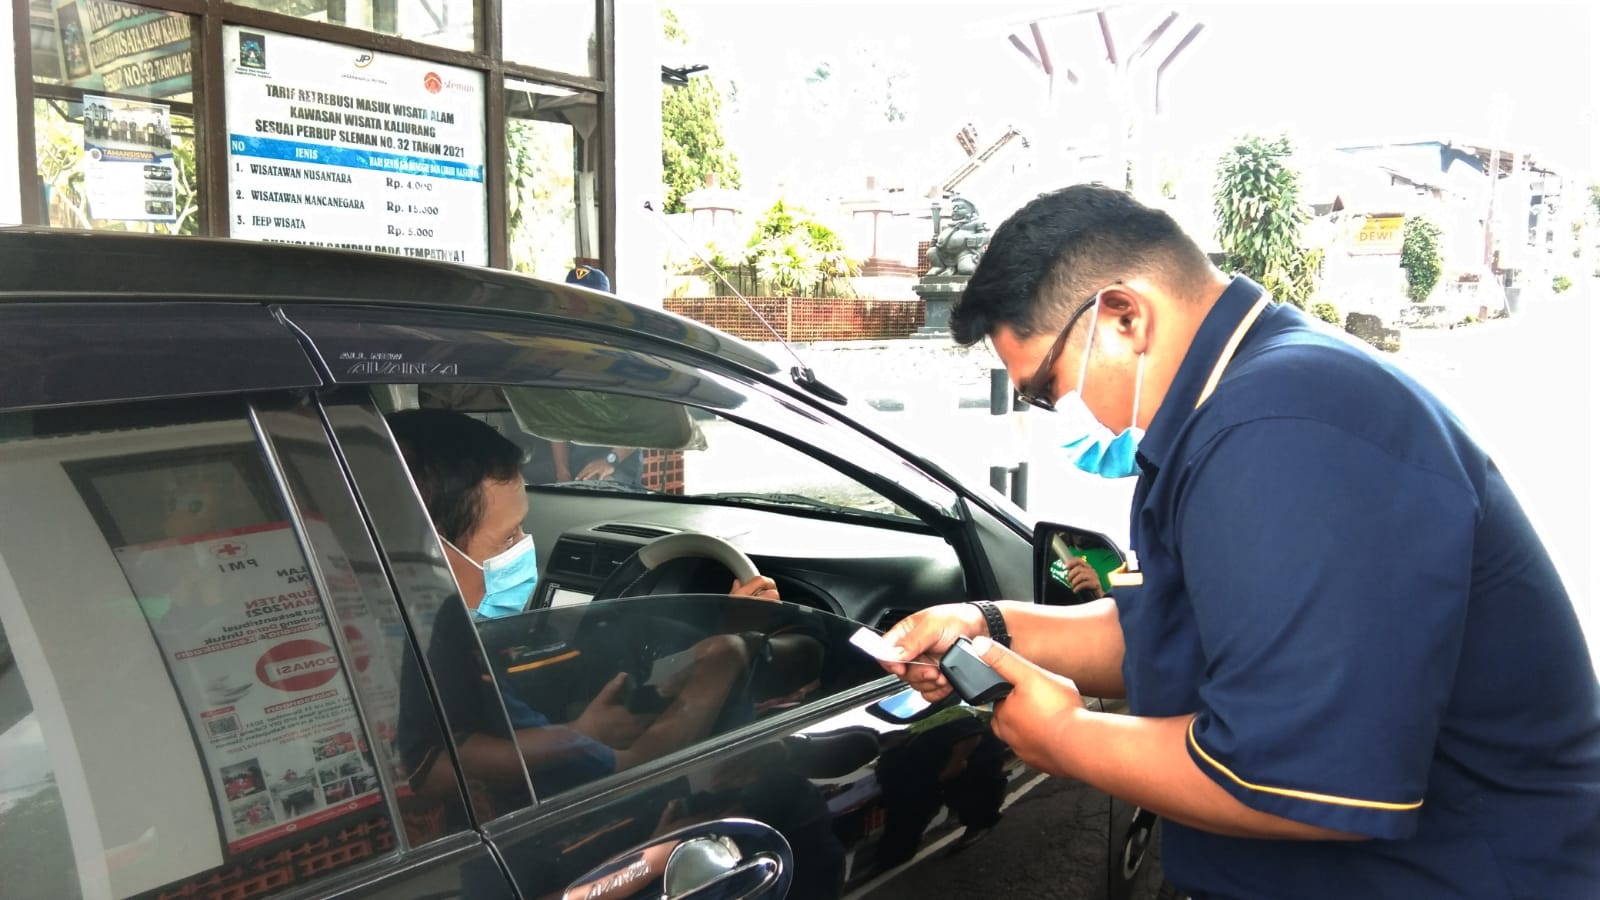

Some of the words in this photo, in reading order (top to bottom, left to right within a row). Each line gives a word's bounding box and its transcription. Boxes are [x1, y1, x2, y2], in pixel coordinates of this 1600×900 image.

[154, 54, 183, 79] TAHUN
[265, 84, 295, 100] TARIF
[298, 89, 354, 109] RETREBUSI
[356, 98, 391, 115] MASUK
[392, 104, 428, 120] WISATA
[430, 111, 454, 125] ALAM
[290, 106, 342, 124] KAWASAN
[344, 113, 382, 130] WISATA
[384, 119, 436, 137] KALIURANG
[231, 140, 246, 151] NO
[255, 119, 294, 136] SESUAI
[296, 125, 337, 141] PERBUP
[339, 130, 378, 146] SLEMAN
[380, 136, 396, 149] NO.
[398, 138, 410, 151] 32
[411, 140, 442, 155] TAHUN
[443, 144, 465, 158] 2021
[236, 162, 243, 172] 1.
[250, 163, 301, 179] WISATAWAN
[303, 169, 352, 184] NUSANTARA
[386, 177, 404, 190] Rp.
[236, 189, 244, 200] 2.
[250, 190, 302, 204] WISATAWAN
[304, 194, 365, 209] MANCANEGARA
[386, 201, 404, 213] Rp.
[237, 215, 245, 225] 3.
[252, 215, 272, 227] JEEP
[273, 217, 306, 229] WISATA
[387, 224, 404, 237] Rp.
[408, 227, 434, 238] 5.000
[1359, 231, 1393, 242] DEWI
[347, 361, 458, 376] AVANZA
